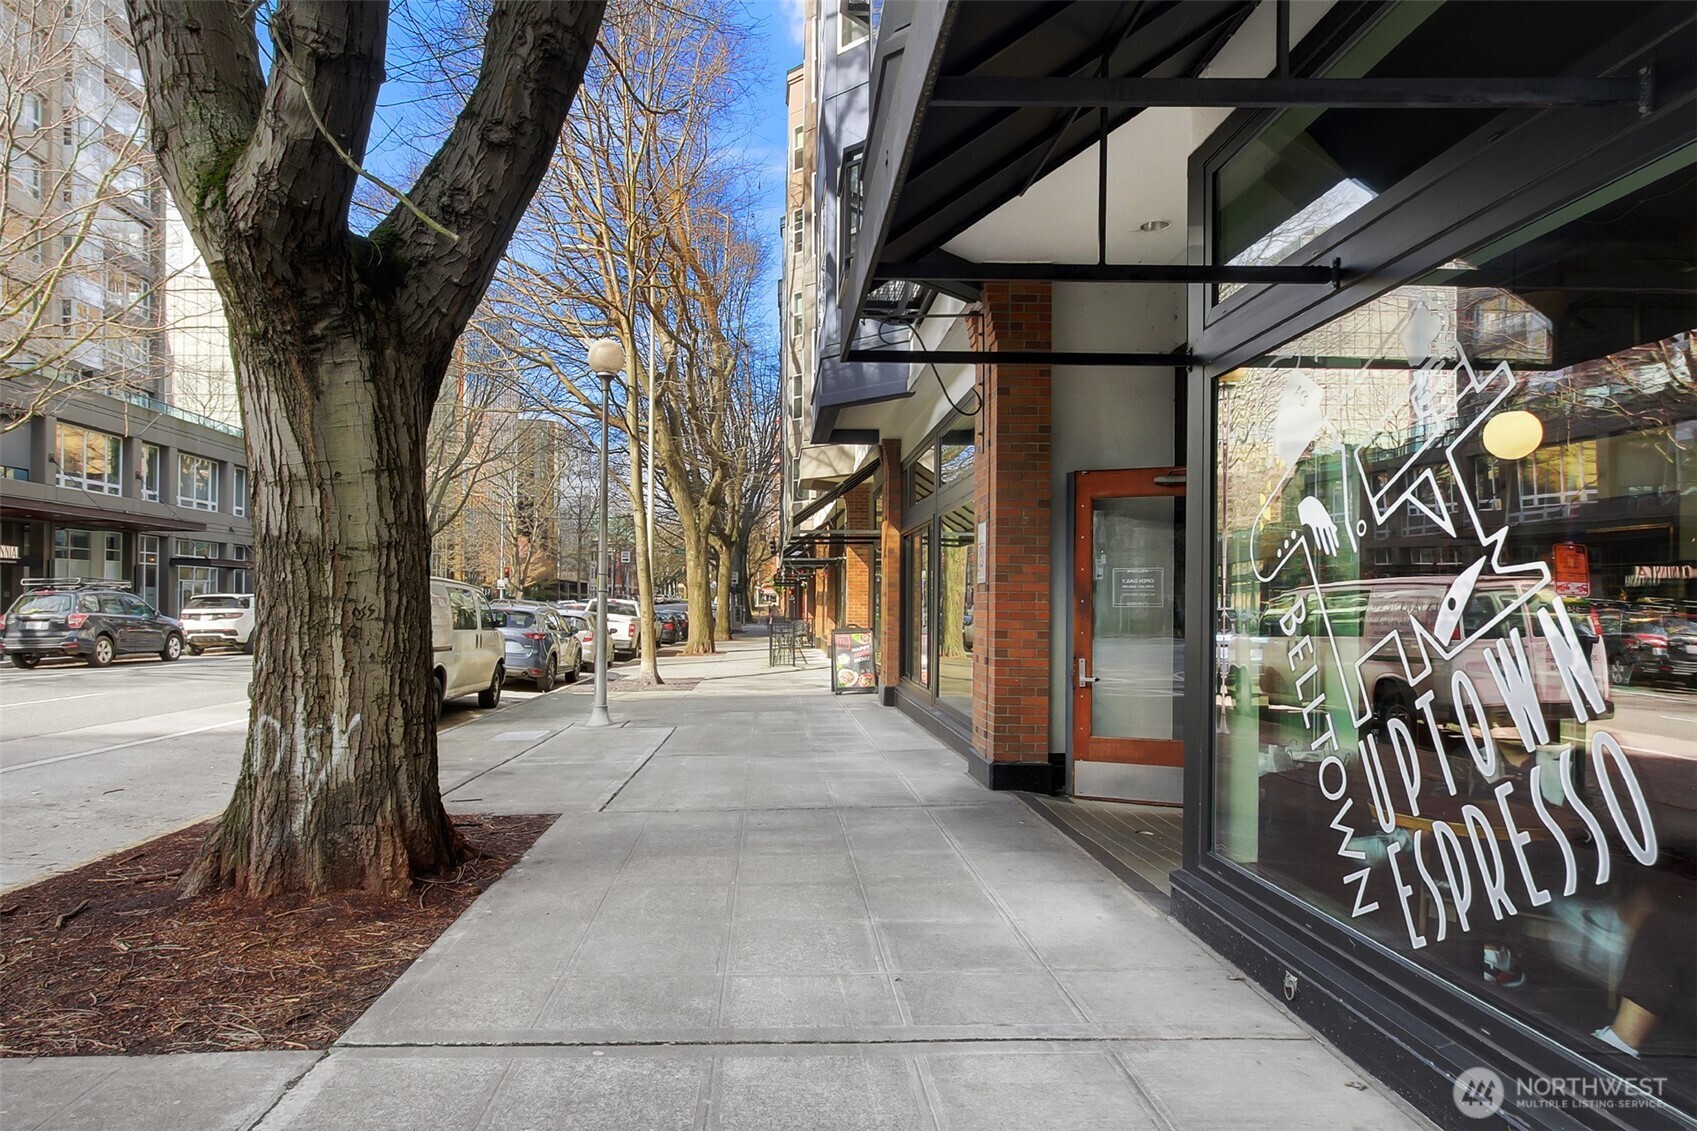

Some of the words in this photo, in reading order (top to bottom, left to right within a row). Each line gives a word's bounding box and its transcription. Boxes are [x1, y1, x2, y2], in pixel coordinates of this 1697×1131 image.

[1279, 596, 1380, 918] BELLTOWN
[1358, 596, 1606, 834] UPTOWN
[1386, 730, 1659, 950] ESPRESSO
